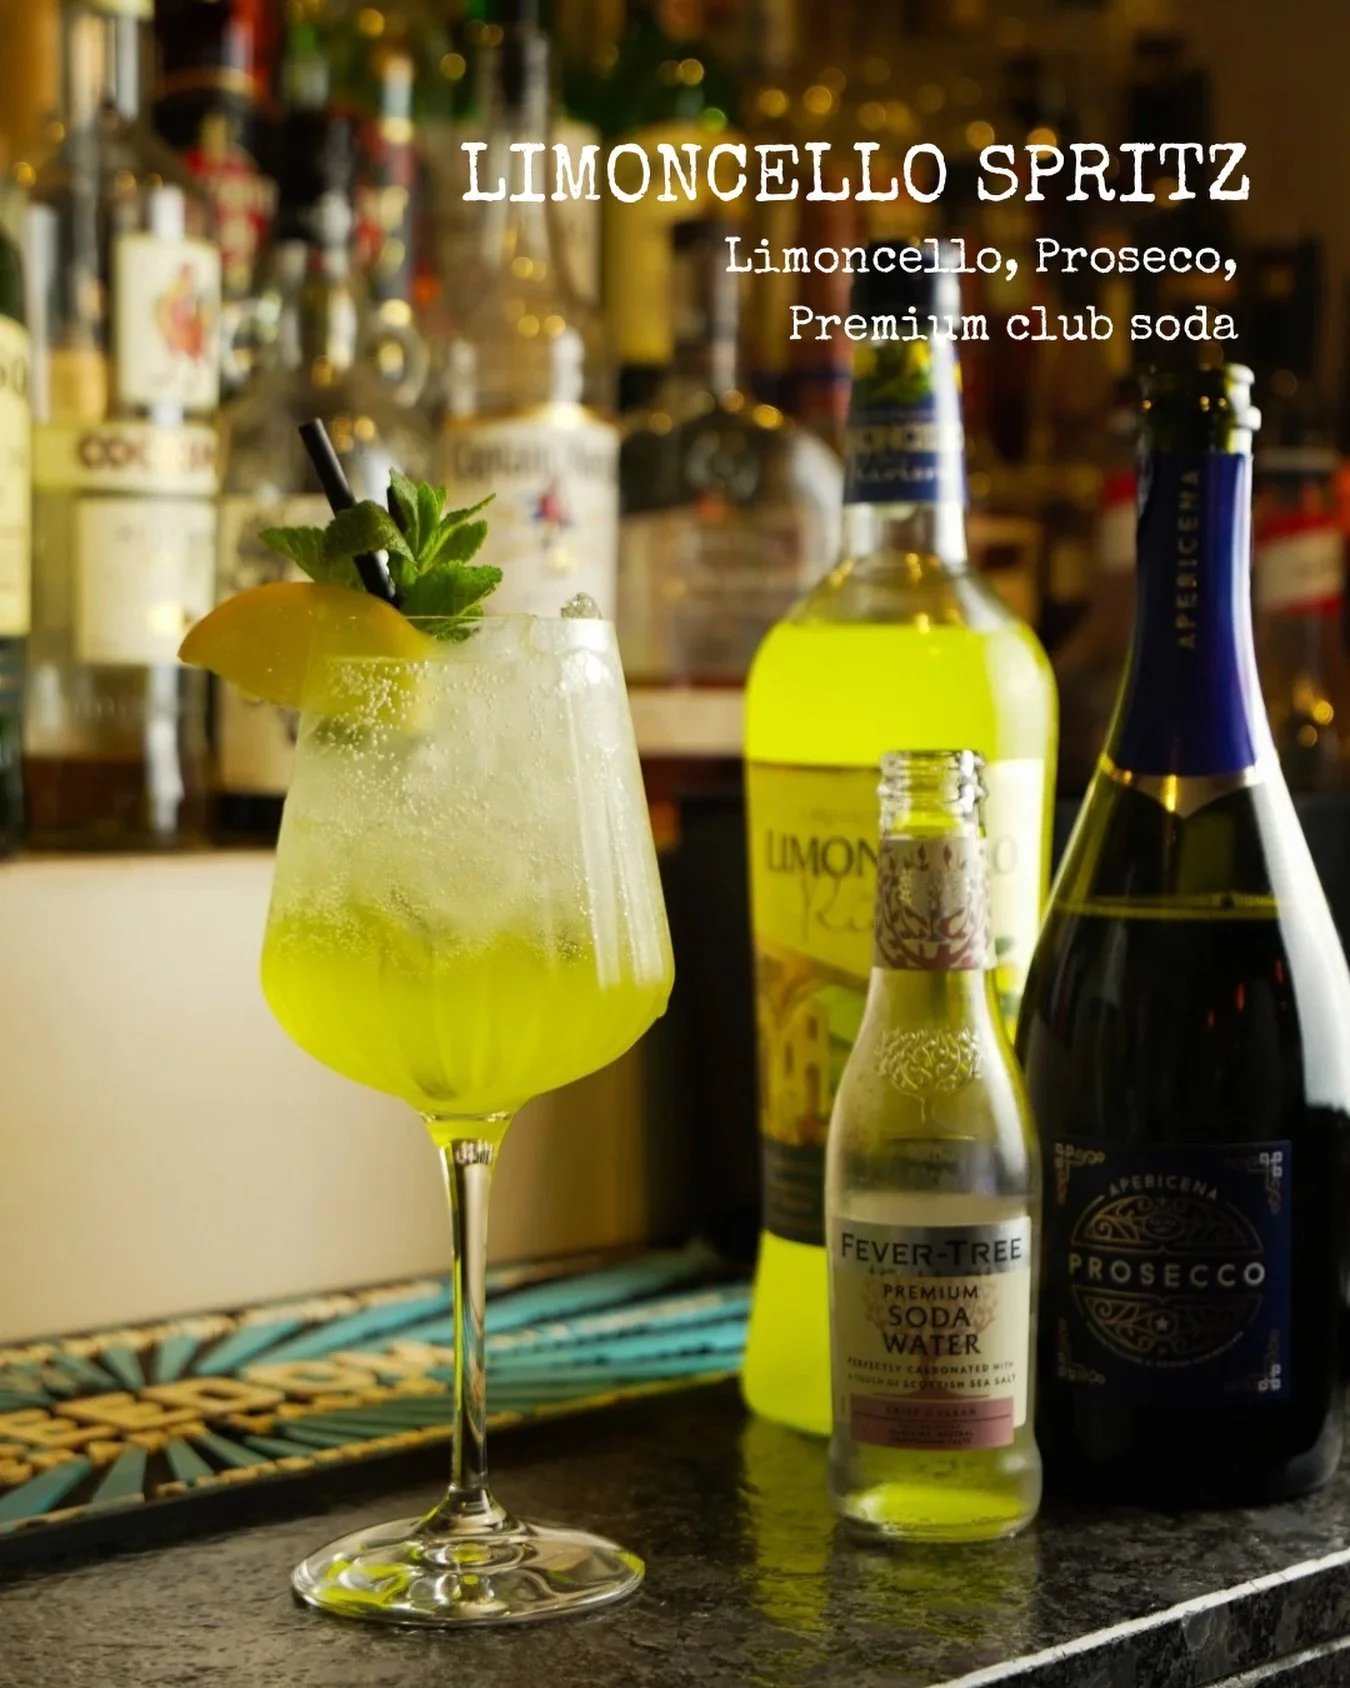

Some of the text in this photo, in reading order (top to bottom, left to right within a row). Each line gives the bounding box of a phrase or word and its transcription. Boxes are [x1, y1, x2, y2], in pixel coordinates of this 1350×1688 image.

[1176, 470, 1199, 649] APERICENA
[1108, 1174, 1217, 1200] APERICENA
[841, 1232, 1022, 1267] FEVER-TREE
[1069, 1253, 1266, 1288] PROSECCO
[883, 1283, 979, 1300] PREMIUM
[888, 1306, 971, 1328] SODA
[882, 1333, 982, 1357] WATER
[847, 1356, 1015, 1375] PERFECTLY CARBONATED WITH
[903, 1378, 965, 1390] SCOTTISH
[970, 1377, 991, 1388] SEA
[995, 1373, 1017, 1385] SALT
